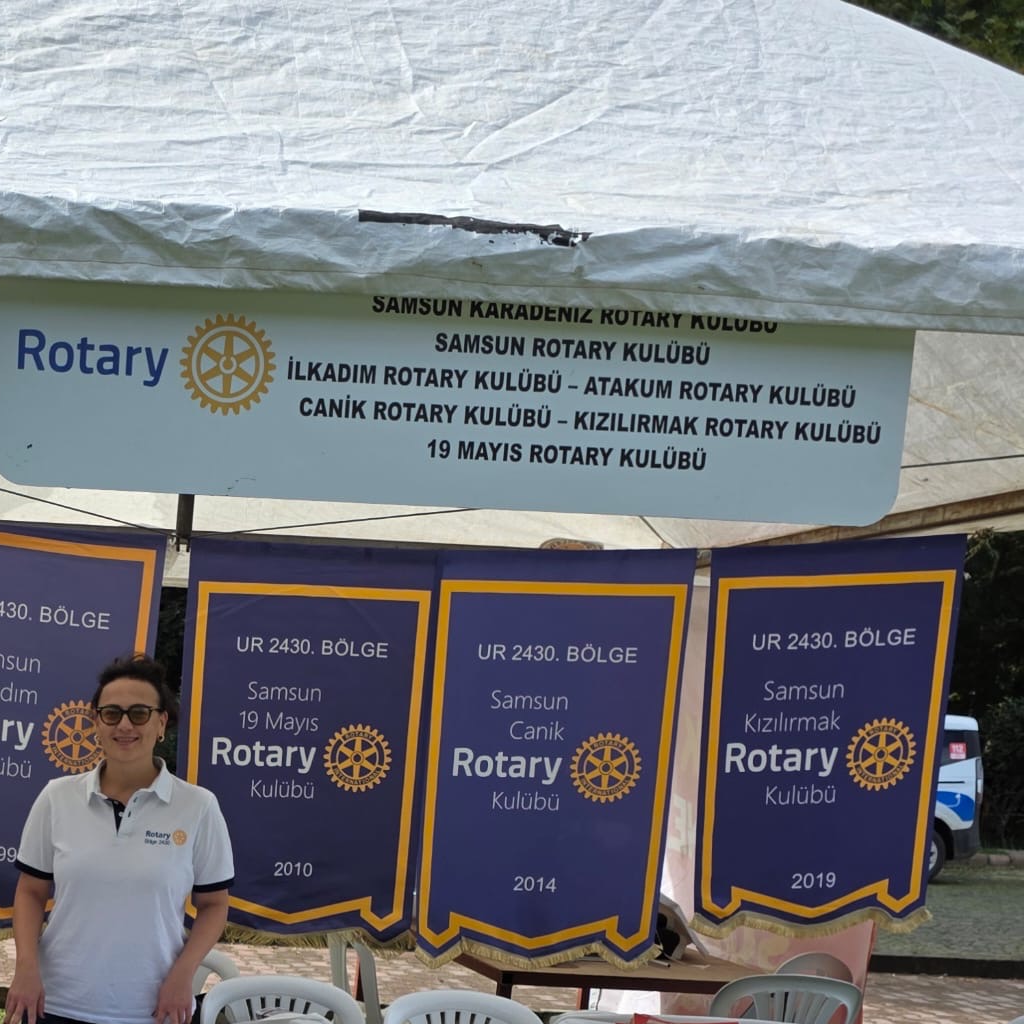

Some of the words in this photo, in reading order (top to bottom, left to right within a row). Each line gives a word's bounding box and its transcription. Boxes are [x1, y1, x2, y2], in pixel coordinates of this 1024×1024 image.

[372, 295, 463, 317] SAMSUN
[600, 308, 682, 329] ROTARY
[16, 328, 169, 388] Rotary
[434, 332, 525, 356] SAMSUN
[532, 337, 616, 361] ROTARY
[622, 340, 711, 366] KULÜBÜ
[287, 356, 377, 384] İLKADIM
[383, 366, 468, 389] ROTARY
[474, 368, 562, 394] KULÜBÜ
[583, 376, 674, 399] ATAKUM
[679, 381, 763, 404] ROTARY
[768, 383, 856, 409] KULÜBÜ
[299, 394, 366, 420] CANİK
[373, 400, 458, 424] ROTARY
[463, 403, 552, 429] KULÜBÜ
[574, 411, 698, 436] KIZILIRMAK
[704, 417, 788, 441] ROTARY
[794, 419, 882, 445] KULÜBÜ
[427, 439, 451, 460] 19
[457, 441, 523, 463] MAYIS
[529, 445, 613, 468] ROTARY
[619, 446, 707, 472] KULÜBÜ
[39, 604, 111, 630] BÖLGE
[236, 636, 264, 654] UR
[269, 637, 315, 657] 2430.
[322, 638, 389, 659] BÖLGE
[752, 633, 781, 651] UR
[787, 631, 837, 650] 2430.
[844, 627, 917, 648] BÖLGE
[478, 643, 506, 661] UR
[511, 644, 560, 663] 2430.
[567, 643, 638, 664] BÖLGE
[248, 681, 322, 703] Samsun
[490, 689, 569, 711] Samsun
[763, 680, 845, 701] Samsun
[239, 710, 261, 730] 19
[265, 712, 319, 735] Mayıs
[509, 720, 565, 742] Canik
[745, 710, 841, 733] Kızılırmak
[211, 736, 317, 774] Rotary
[452, 747, 563, 785] Rotary
[724, 742, 838, 777] Rotary
[250, 779, 315, 801] Kulübü
[491, 791, 560, 812] Kulübü
[765, 785, 836, 806] Kulübü
[146, 830, 171, 840] Rotary
[274, 861, 313, 878] 2010
[791, 872, 836, 889] 2019
[513, 876, 557, 893] 2014
